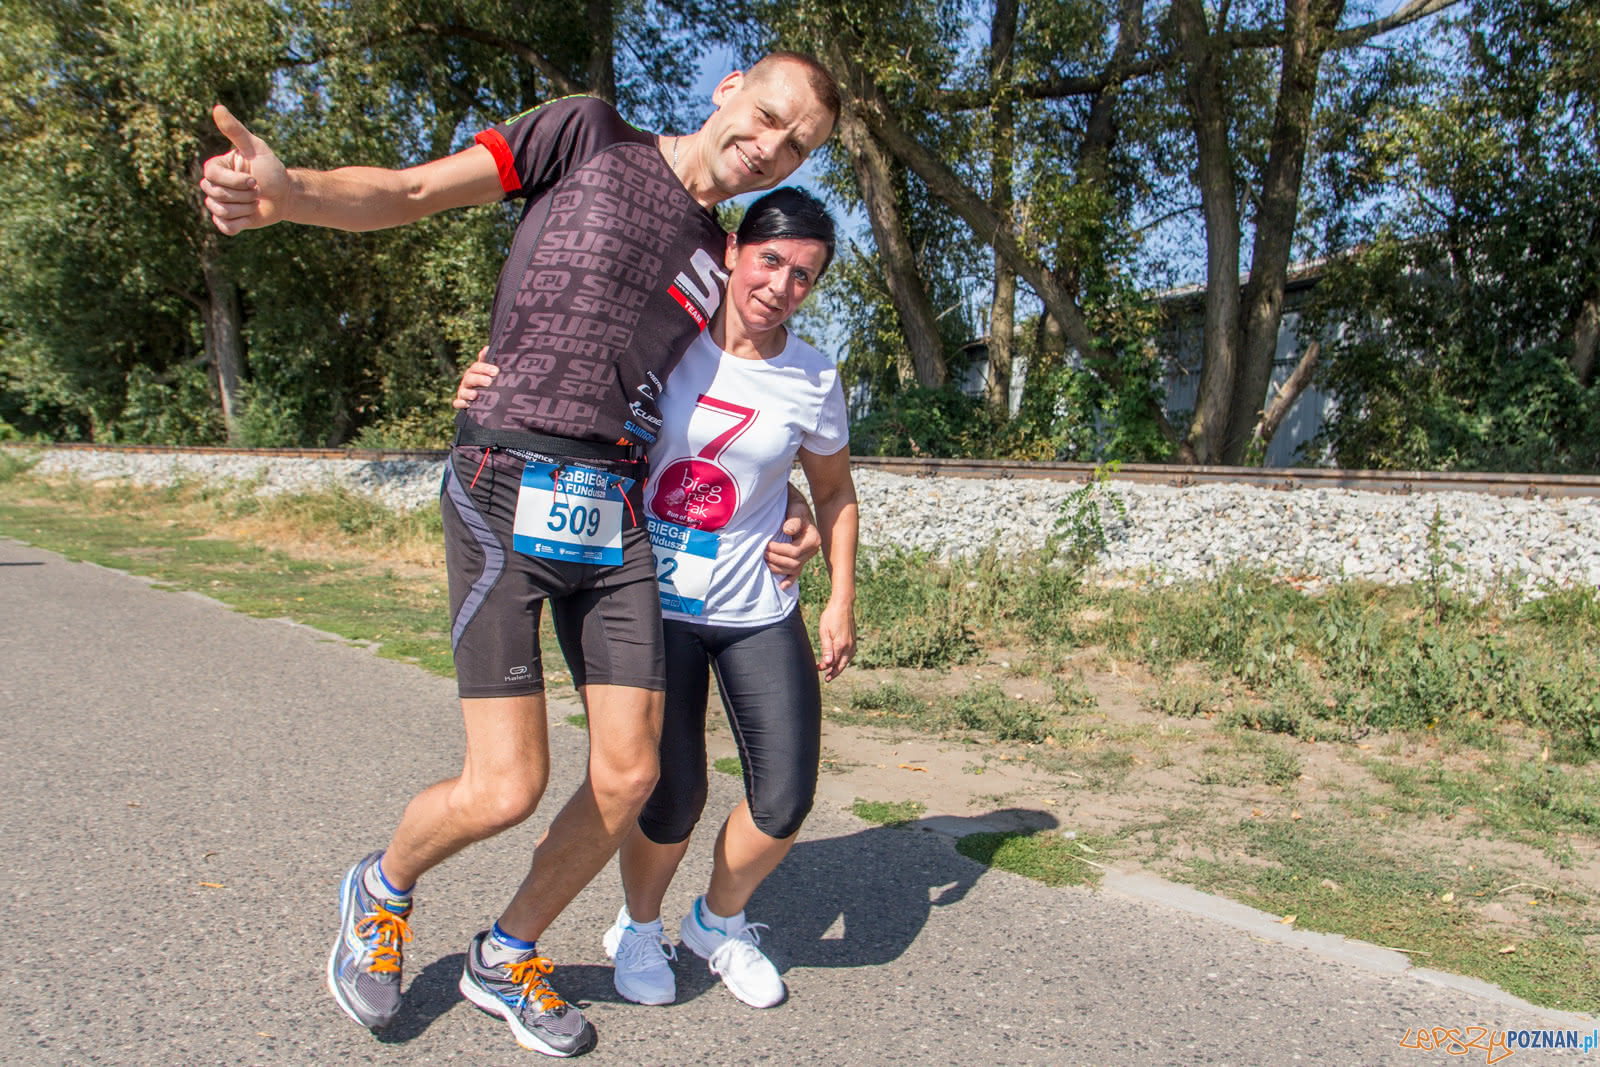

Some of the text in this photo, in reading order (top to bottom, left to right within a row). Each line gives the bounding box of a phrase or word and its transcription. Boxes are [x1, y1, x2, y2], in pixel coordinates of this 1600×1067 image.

[538, 230, 663, 277] SUPER
[684, 300, 703, 324] TEAM
[524, 312, 634, 349] SUPE
[506, 393, 600, 424] SUP
[635, 406, 664, 427] CUBE
[681, 468, 722, 504] bieg
[687, 493, 705, 502] na
[546, 502, 601, 537] 509
[666, 510, 679, 518] Run
[684, 500, 709, 518] tak
[647, 520, 691, 544] BIEGaj
[650, 533, 688, 552] Ndusze
[653, 556, 679, 586] 2
